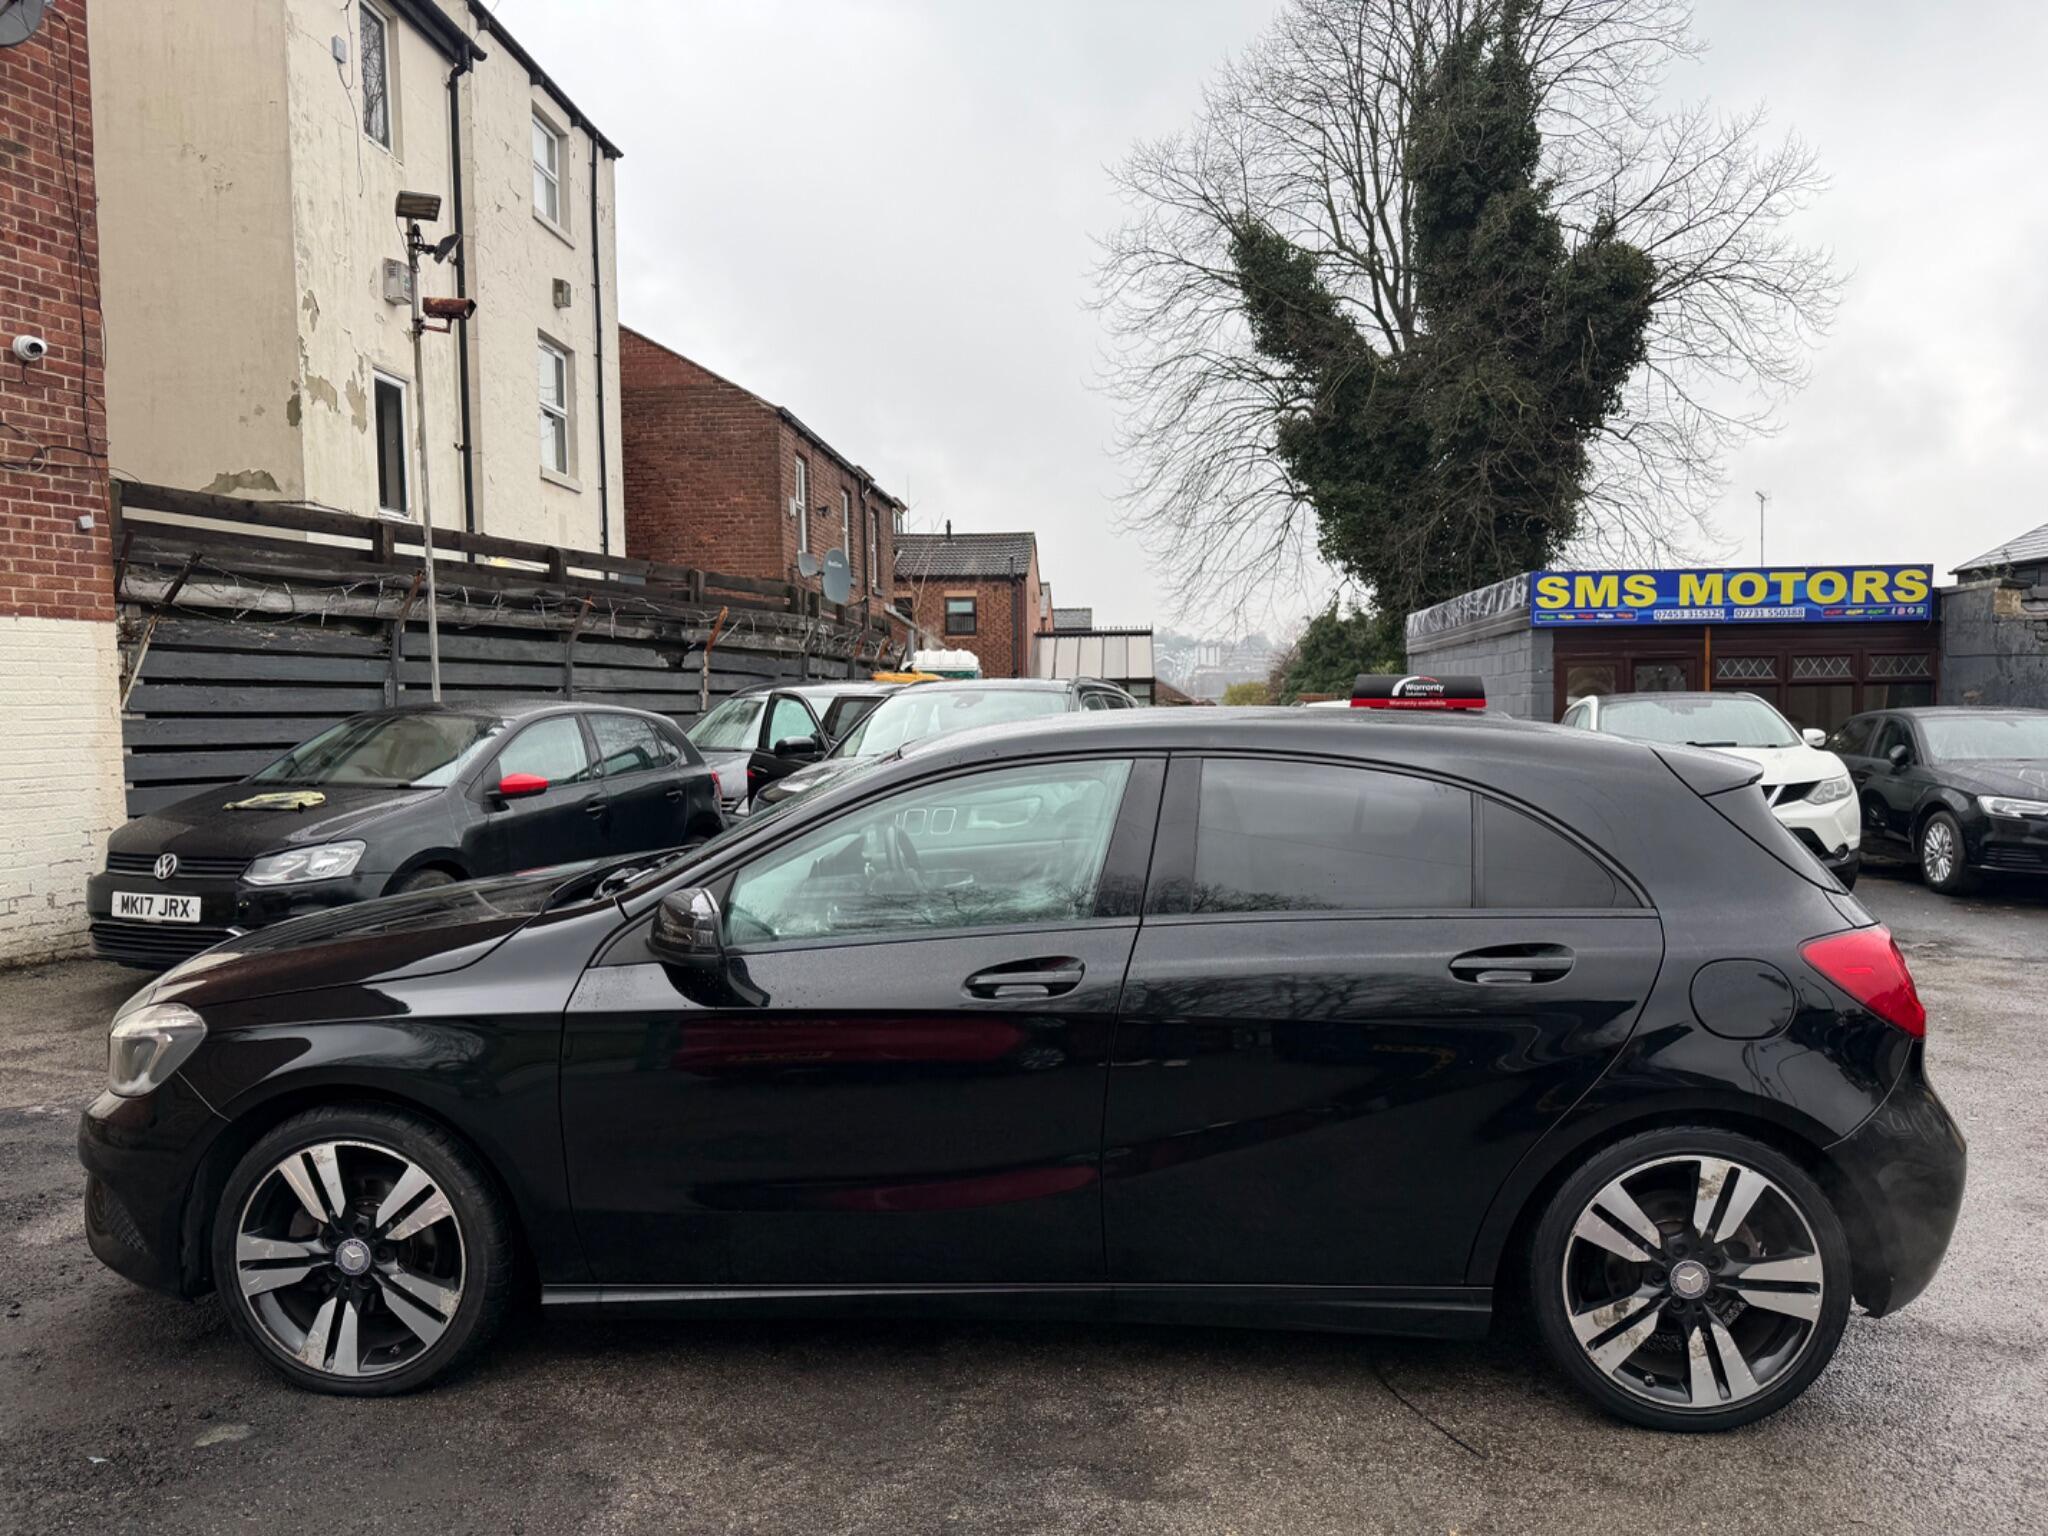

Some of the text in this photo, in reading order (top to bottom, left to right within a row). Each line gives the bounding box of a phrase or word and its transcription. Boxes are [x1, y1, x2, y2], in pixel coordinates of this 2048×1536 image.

[1536, 569, 1929, 609] SMS MOTORS
[1405, 683, 1445, 693] Warranty
[121, 895, 190, 918] MK17 JRX
